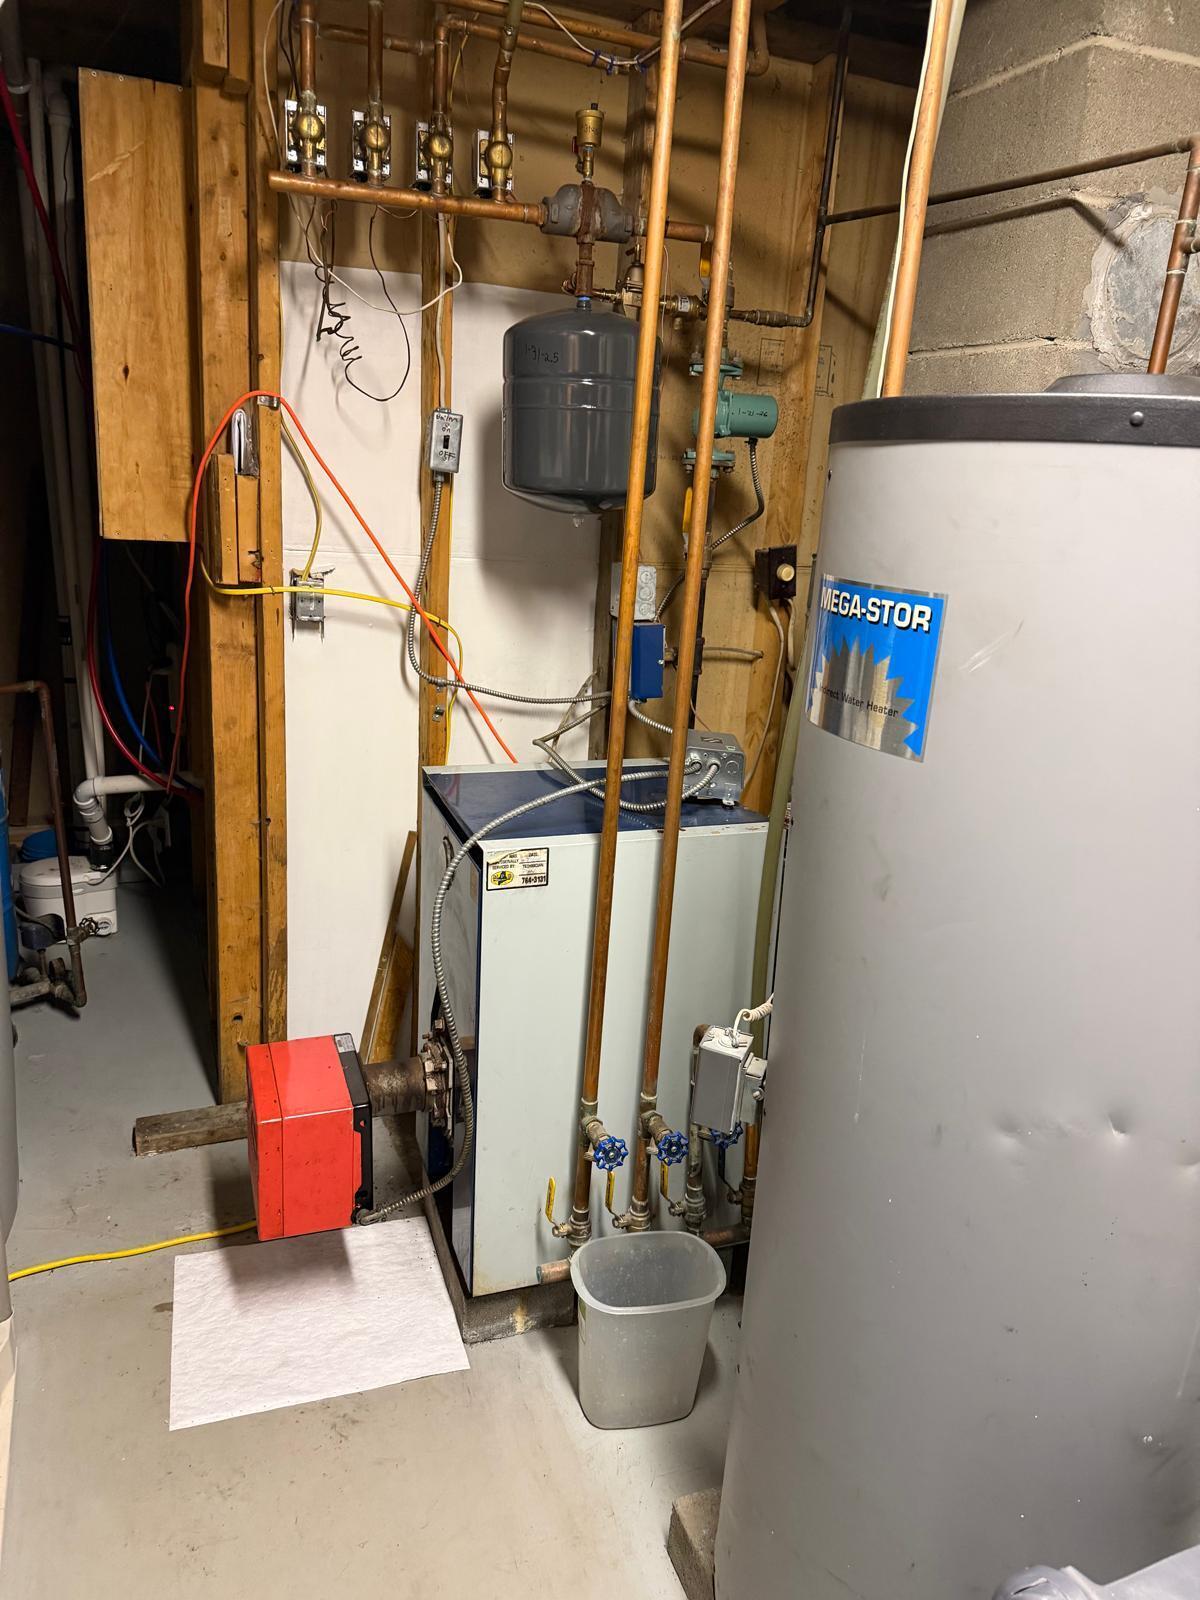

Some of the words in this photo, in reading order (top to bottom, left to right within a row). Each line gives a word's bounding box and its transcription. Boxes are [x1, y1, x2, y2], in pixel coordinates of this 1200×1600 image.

[820, 586, 933, 634] MEGA-STOR
[820, 683, 839, 700] direct
[841, 692, 865, 707] Water
[866, 700, 899, 718] Heater
